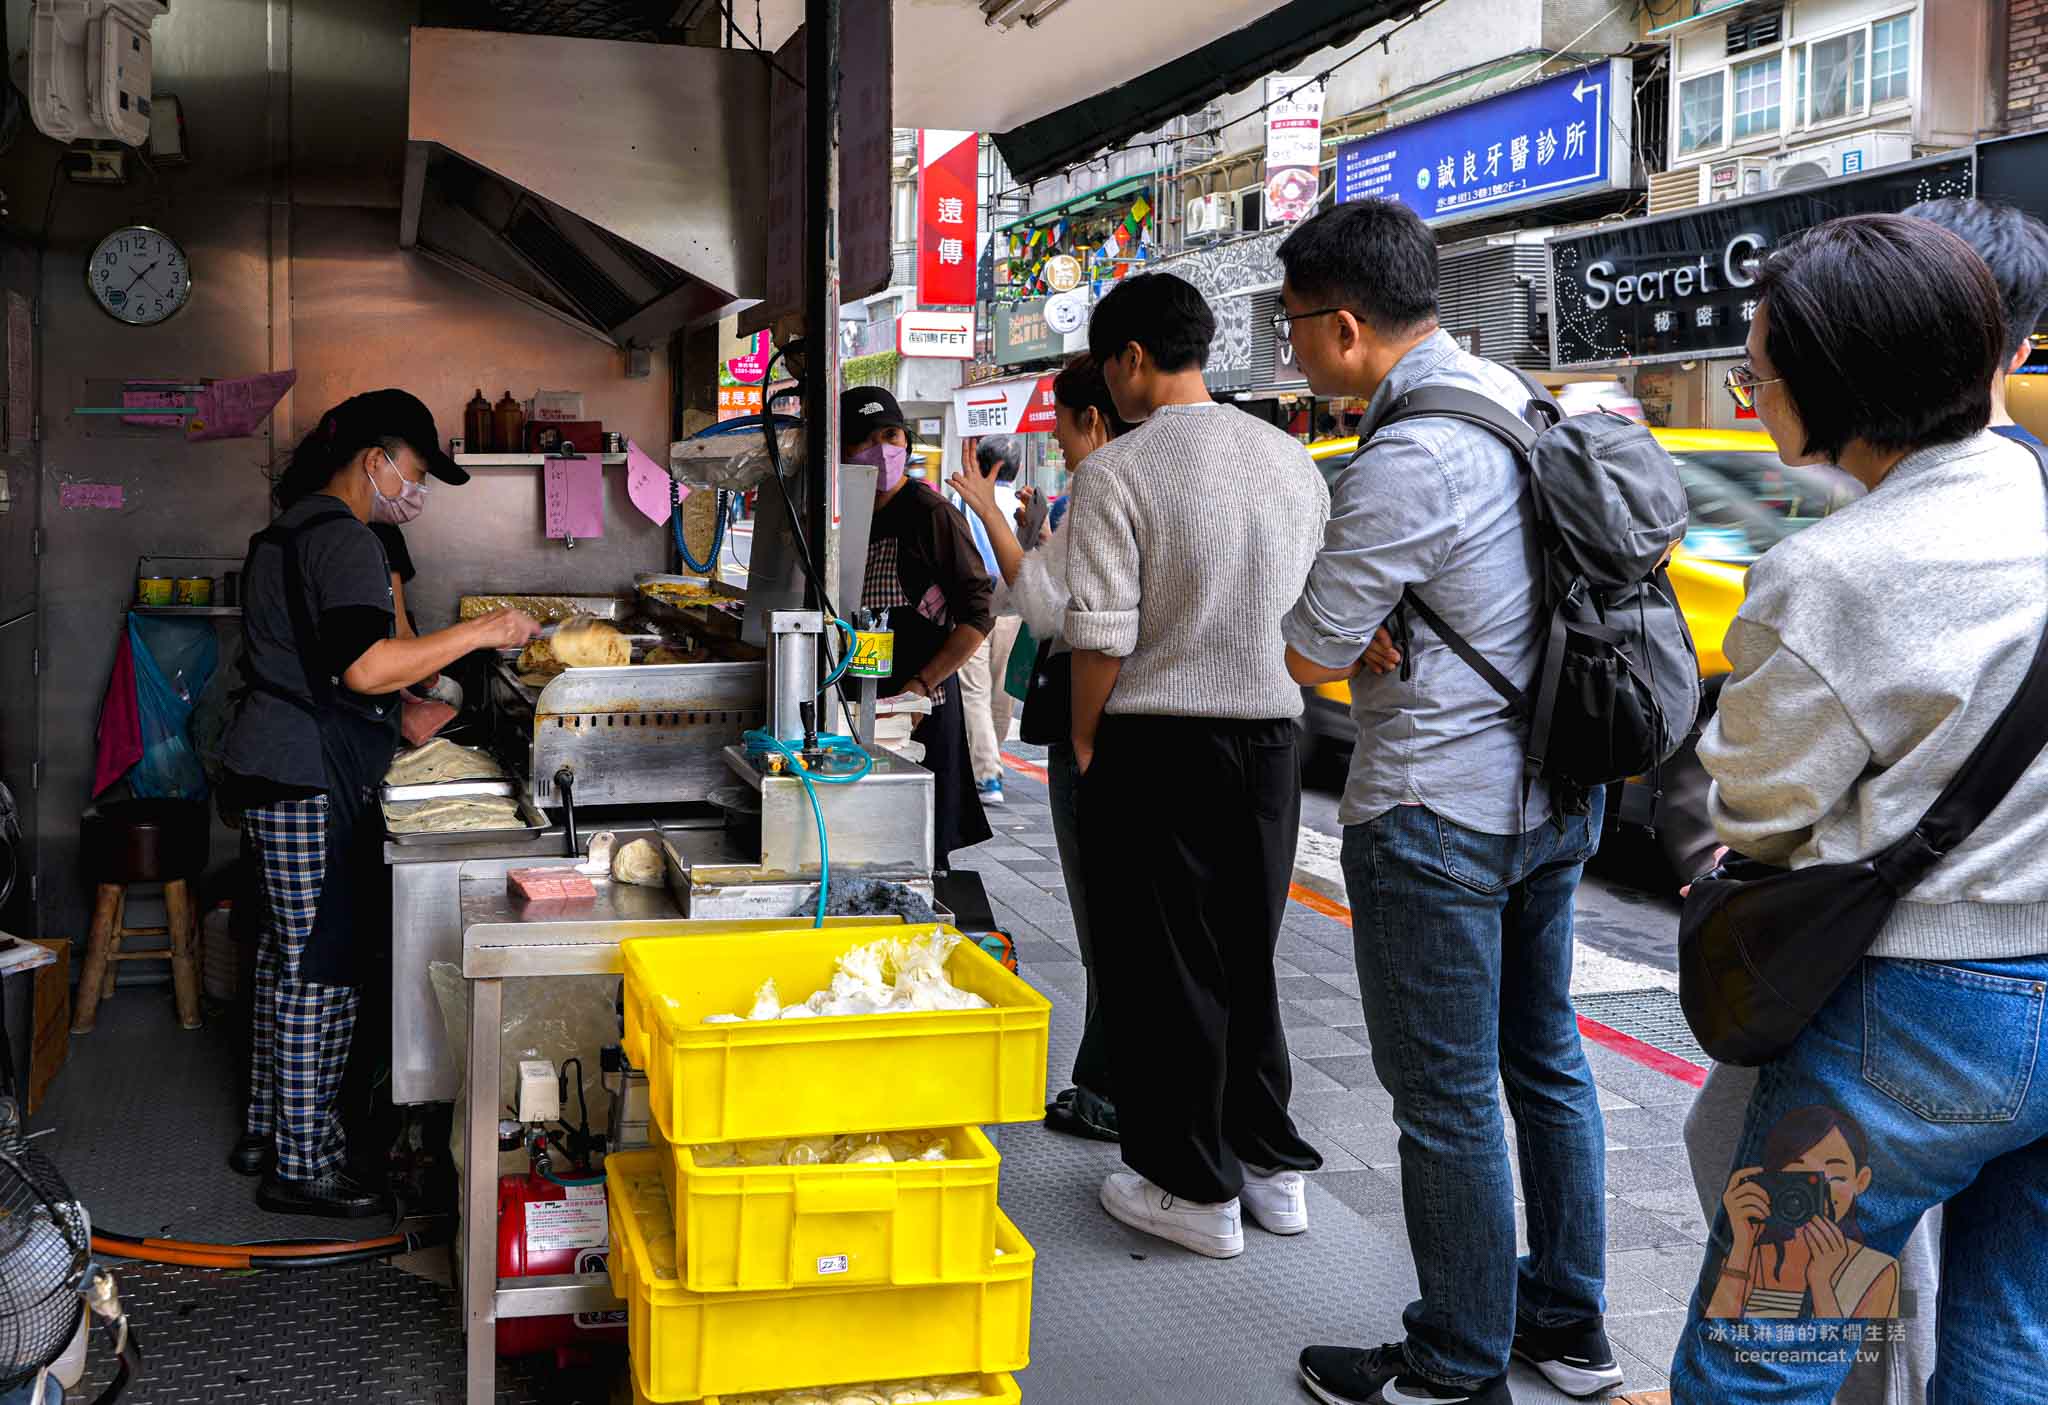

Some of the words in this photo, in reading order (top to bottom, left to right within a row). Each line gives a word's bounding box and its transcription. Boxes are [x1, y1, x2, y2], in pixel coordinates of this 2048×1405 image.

[1437, 120, 1587, 189] 誠良牙醫診所
[938, 197, 964, 265] 遠傳
[120, 240, 129, 253] 11
[134, 236, 146, 250] 12
[156, 241, 161, 254] 1
[105, 252, 118, 265] 10
[167, 253, 176, 266] 2
[101, 270, 109, 282] 9
[171, 271, 180, 284] 3
[1585, 256, 1710, 310] Secret
[165, 288, 175, 299] 4
[136, 303, 145, 316] 6
[155, 299, 164, 312] 5
